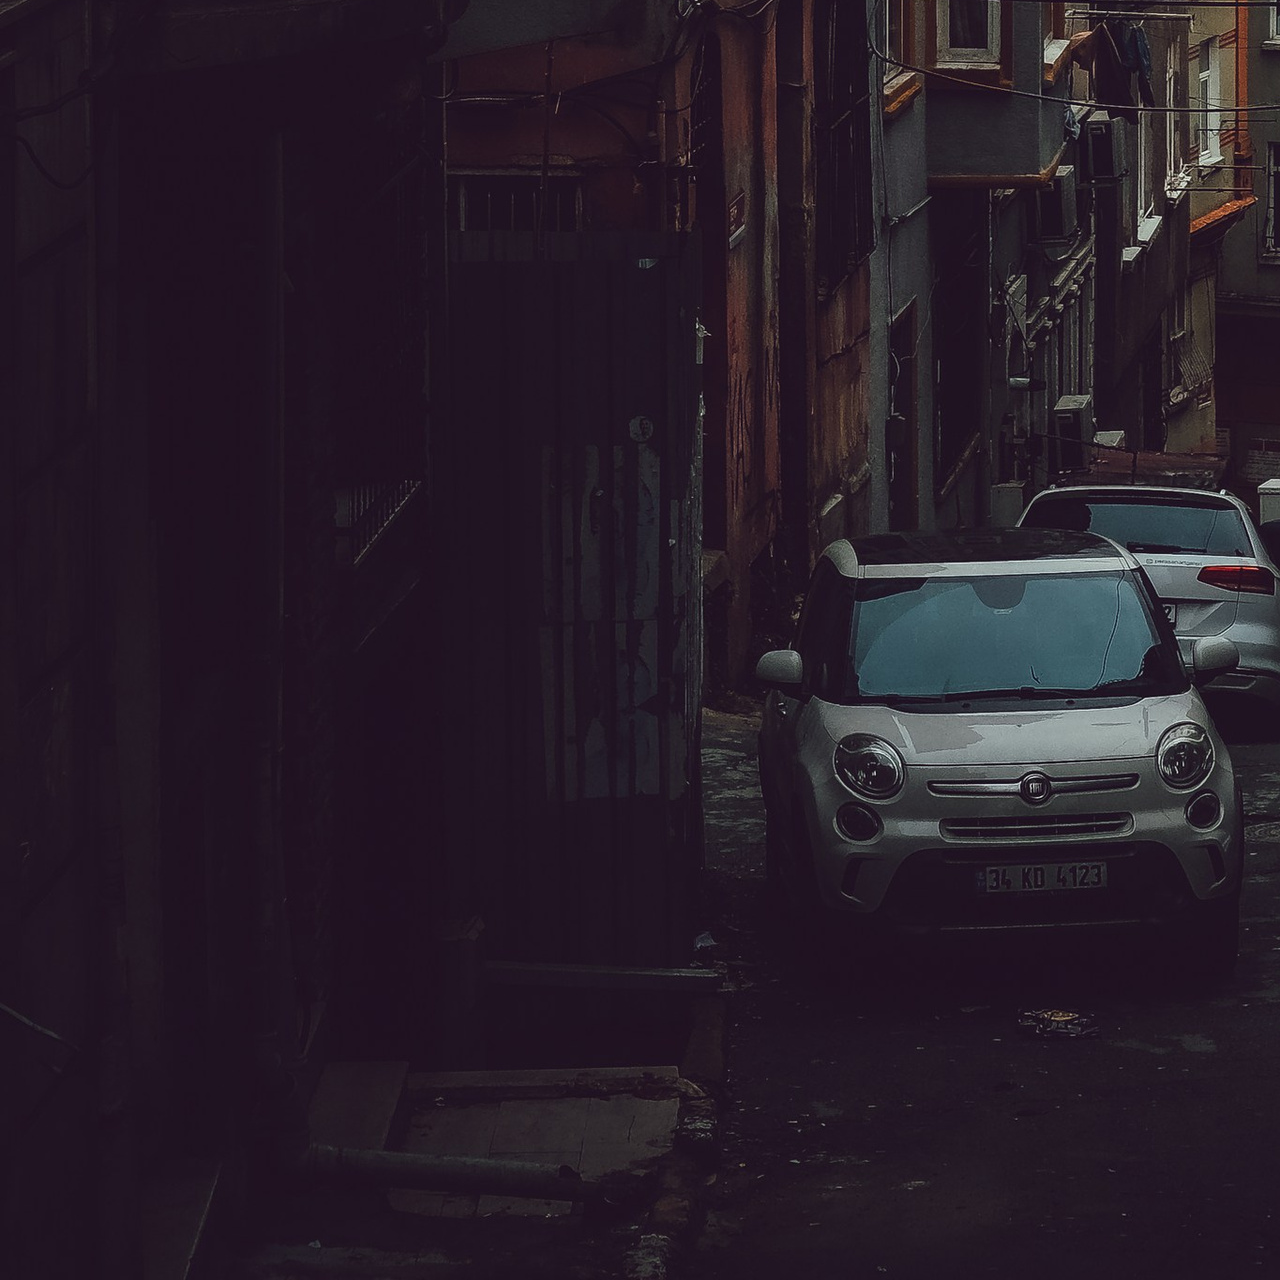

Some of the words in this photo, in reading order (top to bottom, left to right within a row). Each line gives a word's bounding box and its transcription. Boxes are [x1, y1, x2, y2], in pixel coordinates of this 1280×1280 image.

[1029, 782, 1042, 793] FIAT
[989, 868, 1012, 889] 34
[1021, 866, 1045, 889] KD
[1056, 865, 1103, 887] 4123
